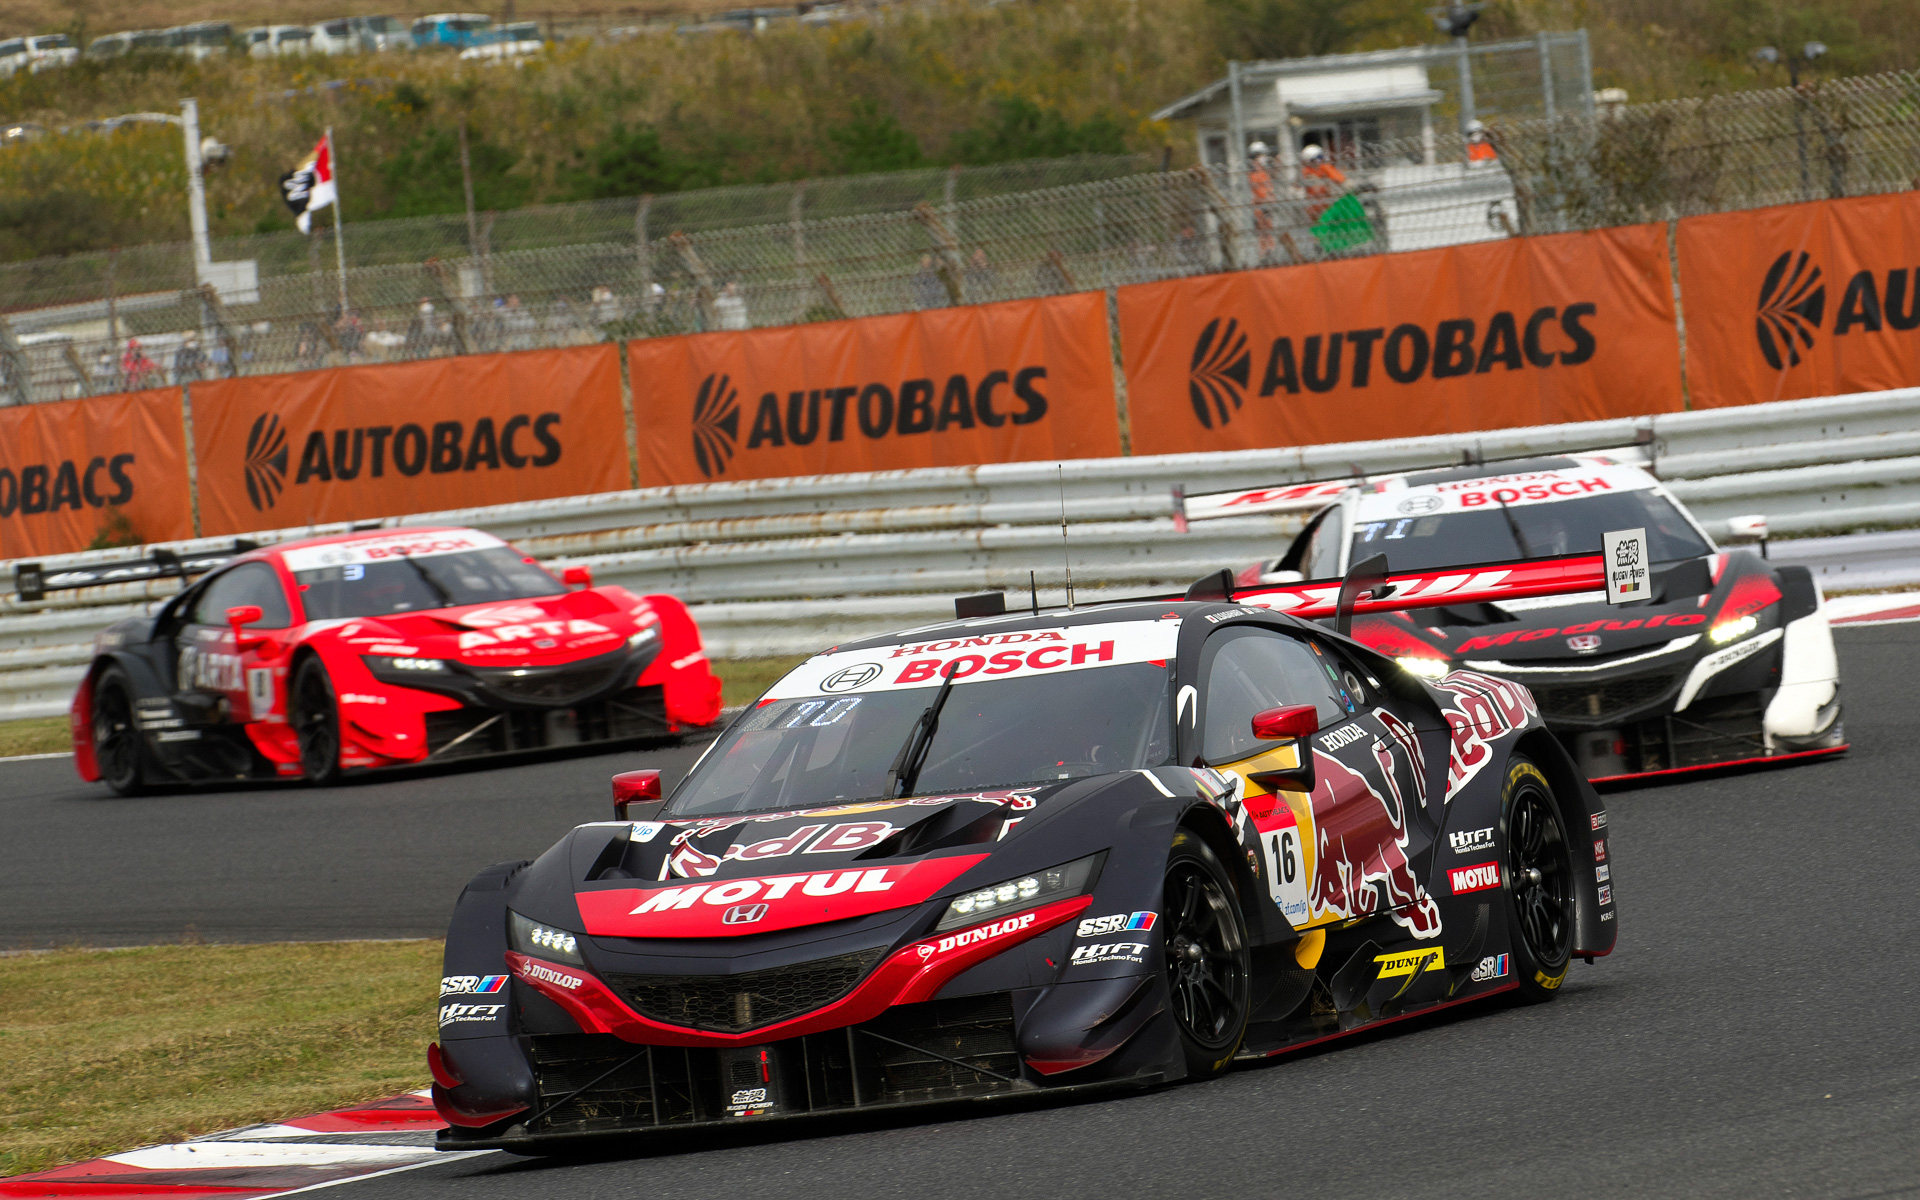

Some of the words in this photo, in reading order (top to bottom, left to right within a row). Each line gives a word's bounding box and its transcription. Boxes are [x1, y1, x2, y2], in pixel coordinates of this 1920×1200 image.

[1260, 303, 1597, 397] AUTOBACS
[746, 366, 1049, 449] AUTOBACS
[295, 413, 562, 484] AUTOBACS
[1436, 472, 1561, 493] HONDA
[1460, 477, 1612, 507] BOSCH
[366, 539, 476, 560] BOSCH
[343, 564, 365, 581] 3
[459, 619, 611, 650] ARTA
[887, 631, 1066, 659] HONDA
[1454, 613, 1707, 654] Modulo
[893, 640, 1115, 685] BOSCH
[1319, 722, 1369, 752] HONDA
[1271, 831, 1296, 886] 16
[628, 868, 896, 915] MOTUL
[1453, 865, 1499, 892] MOTUL
[938, 913, 1035, 953] DUNLOP
[1077, 914, 1126, 937] SSR
[1072, 958, 1098, 966] Honda
[1098, 954, 1126, 962] Techno
[1126, 955, 1143, 964] Fort
[530, 964, 583, 990] DUNLOP
